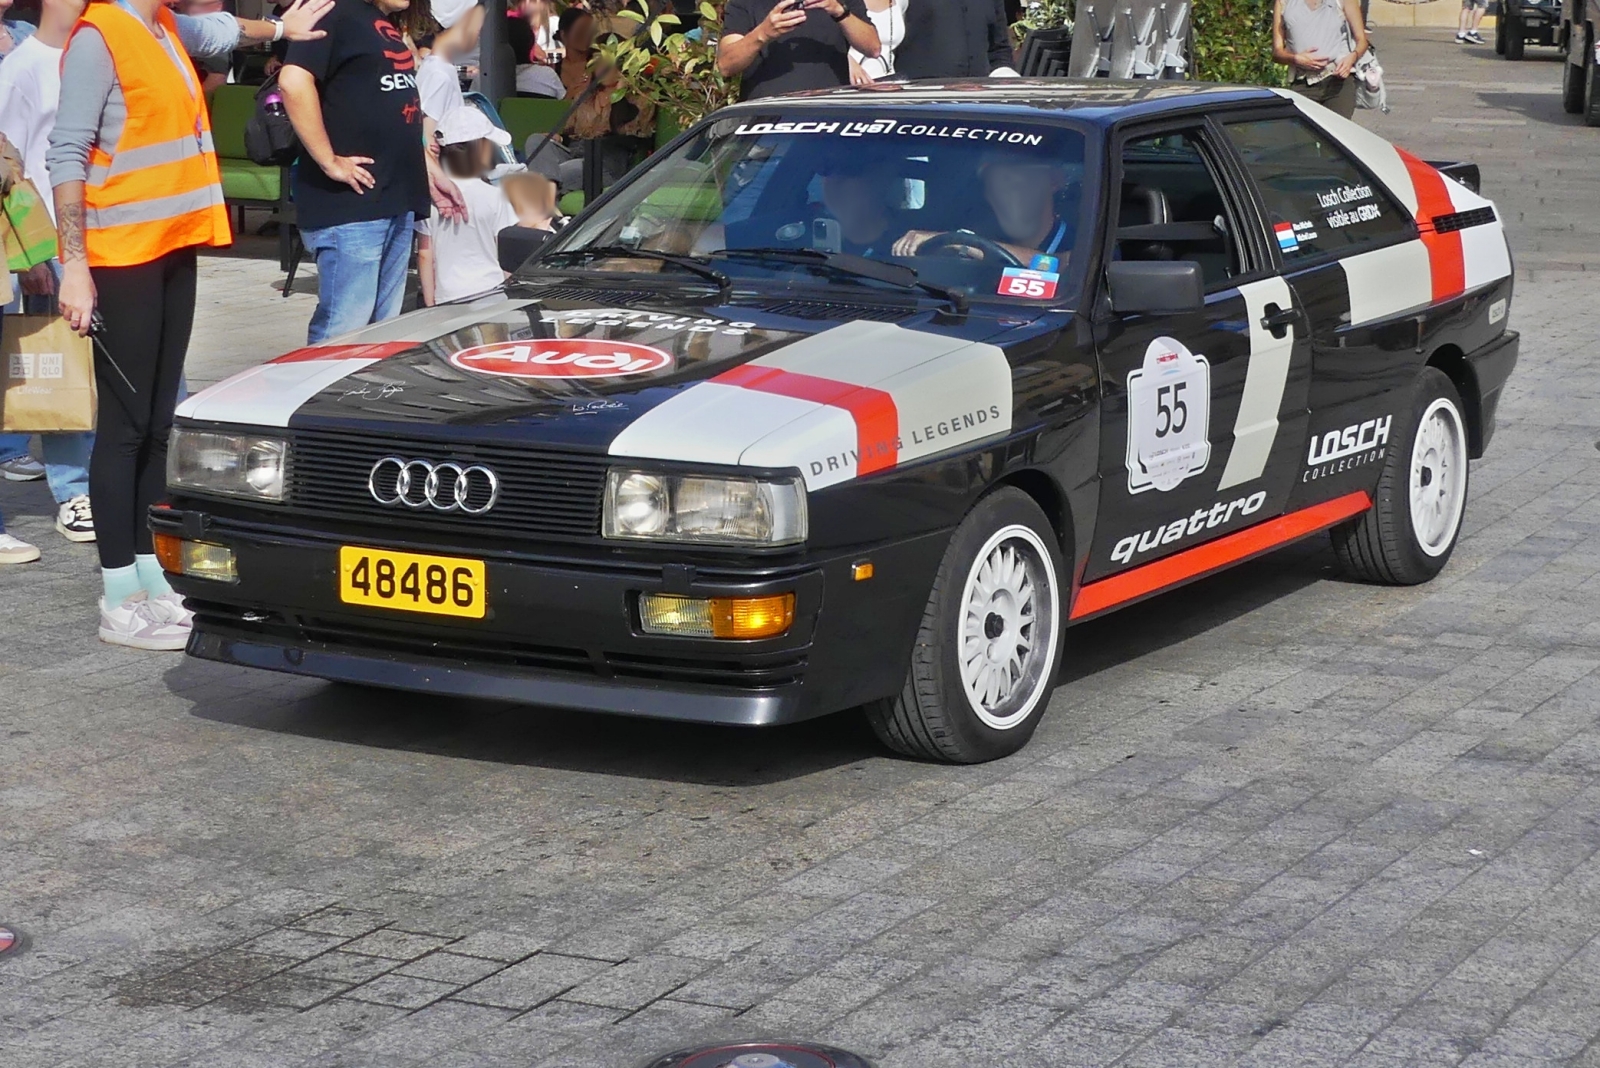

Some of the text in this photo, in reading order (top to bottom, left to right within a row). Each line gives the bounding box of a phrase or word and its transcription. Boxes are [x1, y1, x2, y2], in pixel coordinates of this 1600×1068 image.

[734, 122, 839, 135] LOSCH
[896, 123, 1043, 146] COLLECTION
[1316, 183, 1373, 208] Losch Collection
[1326, 209, 1351, 229] visible
[1008, 278, 1046, 297] 55
[538, 316, 749, 336] LEGENDS
[566, 309, 756, 328] DRIVING
[42, 356, 60, 365] UNI
[42, 366, 60, 376] QLO
[463, 345, 653, 372] Audi
[1155, 381, 1187, 438] 55
[810, 405, 1000, 476] DRIVING LEGENDS
[1307, 414, 1393, 466] LOSCH
[1302, 447, 1386, 483] COLLECTION
[1110, 490, 1267, 564] quattro
[351, 556, 474, 608] 48486
